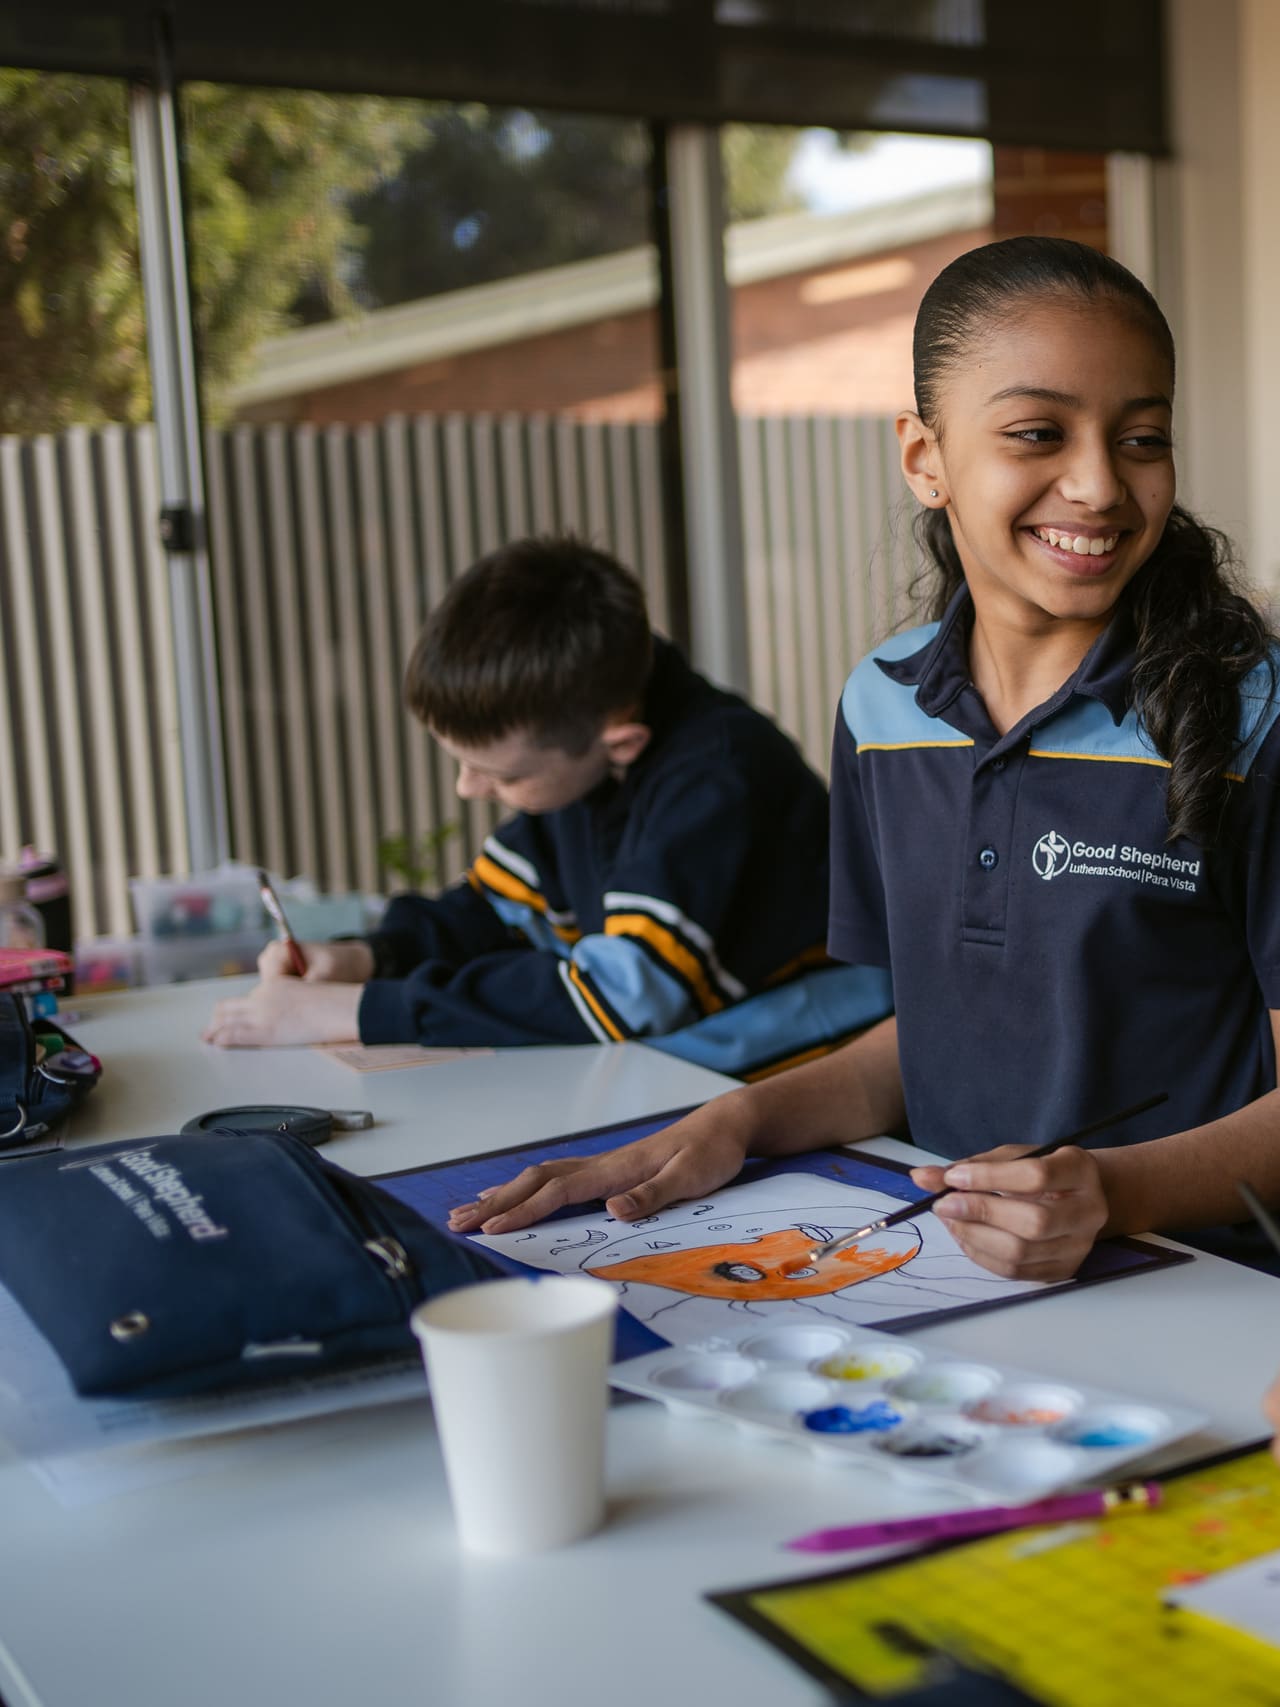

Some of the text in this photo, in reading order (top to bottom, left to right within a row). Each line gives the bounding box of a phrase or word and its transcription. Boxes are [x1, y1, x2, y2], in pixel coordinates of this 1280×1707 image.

[1072, 841, 1200, 876] Good Shepherd
[1170, 877, 1196, 892] Vista
[118, 1151, 171, 1176] Good
[143, 1166, 229, 1241] Shepherd
